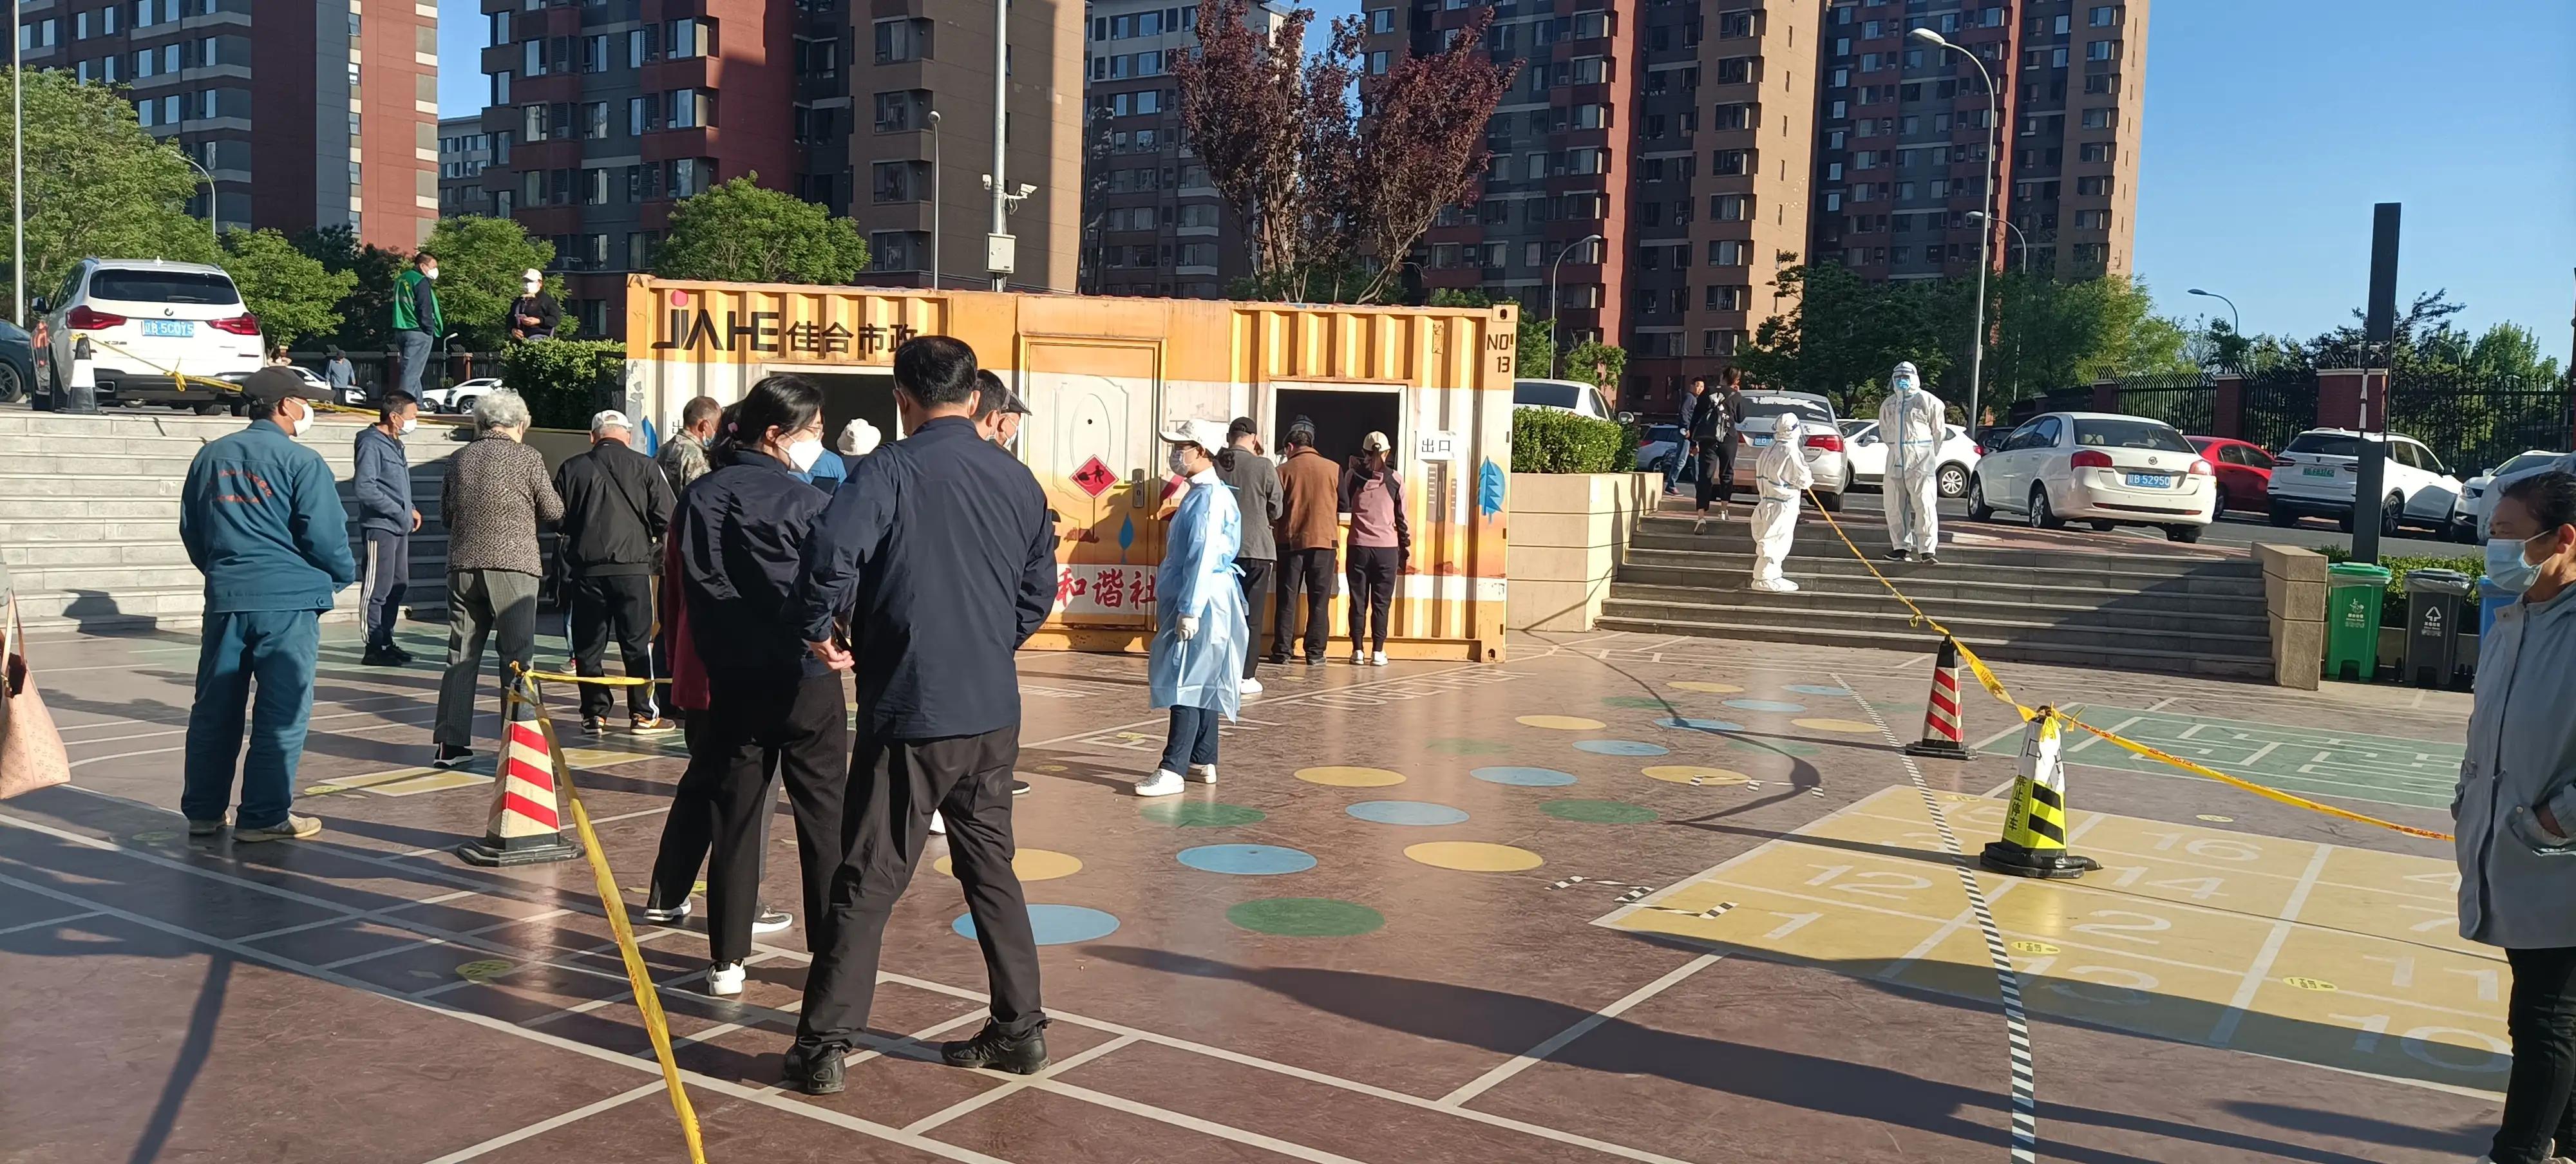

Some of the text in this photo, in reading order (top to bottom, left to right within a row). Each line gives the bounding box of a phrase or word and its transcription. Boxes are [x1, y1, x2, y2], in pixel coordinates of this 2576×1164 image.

[1496, 356, 1511, 373] 13
[1421, 438, 1450, 453] 出口
[1056, 567, 1159, 610] 和谐社
[2008, 774, 2027, 831] 禁止停车
[2142, 831, 2263, 861] 16
[1804, 863, 1933, 900] 12
[2103, 865, 2230, 899] 14
[1763, 912, 1823, 940] 1
[2070, 910, 2172, 944] 2
[2362, 957, 2499, 1001] 11
[2328, 1014, 2514, 1072] 10
